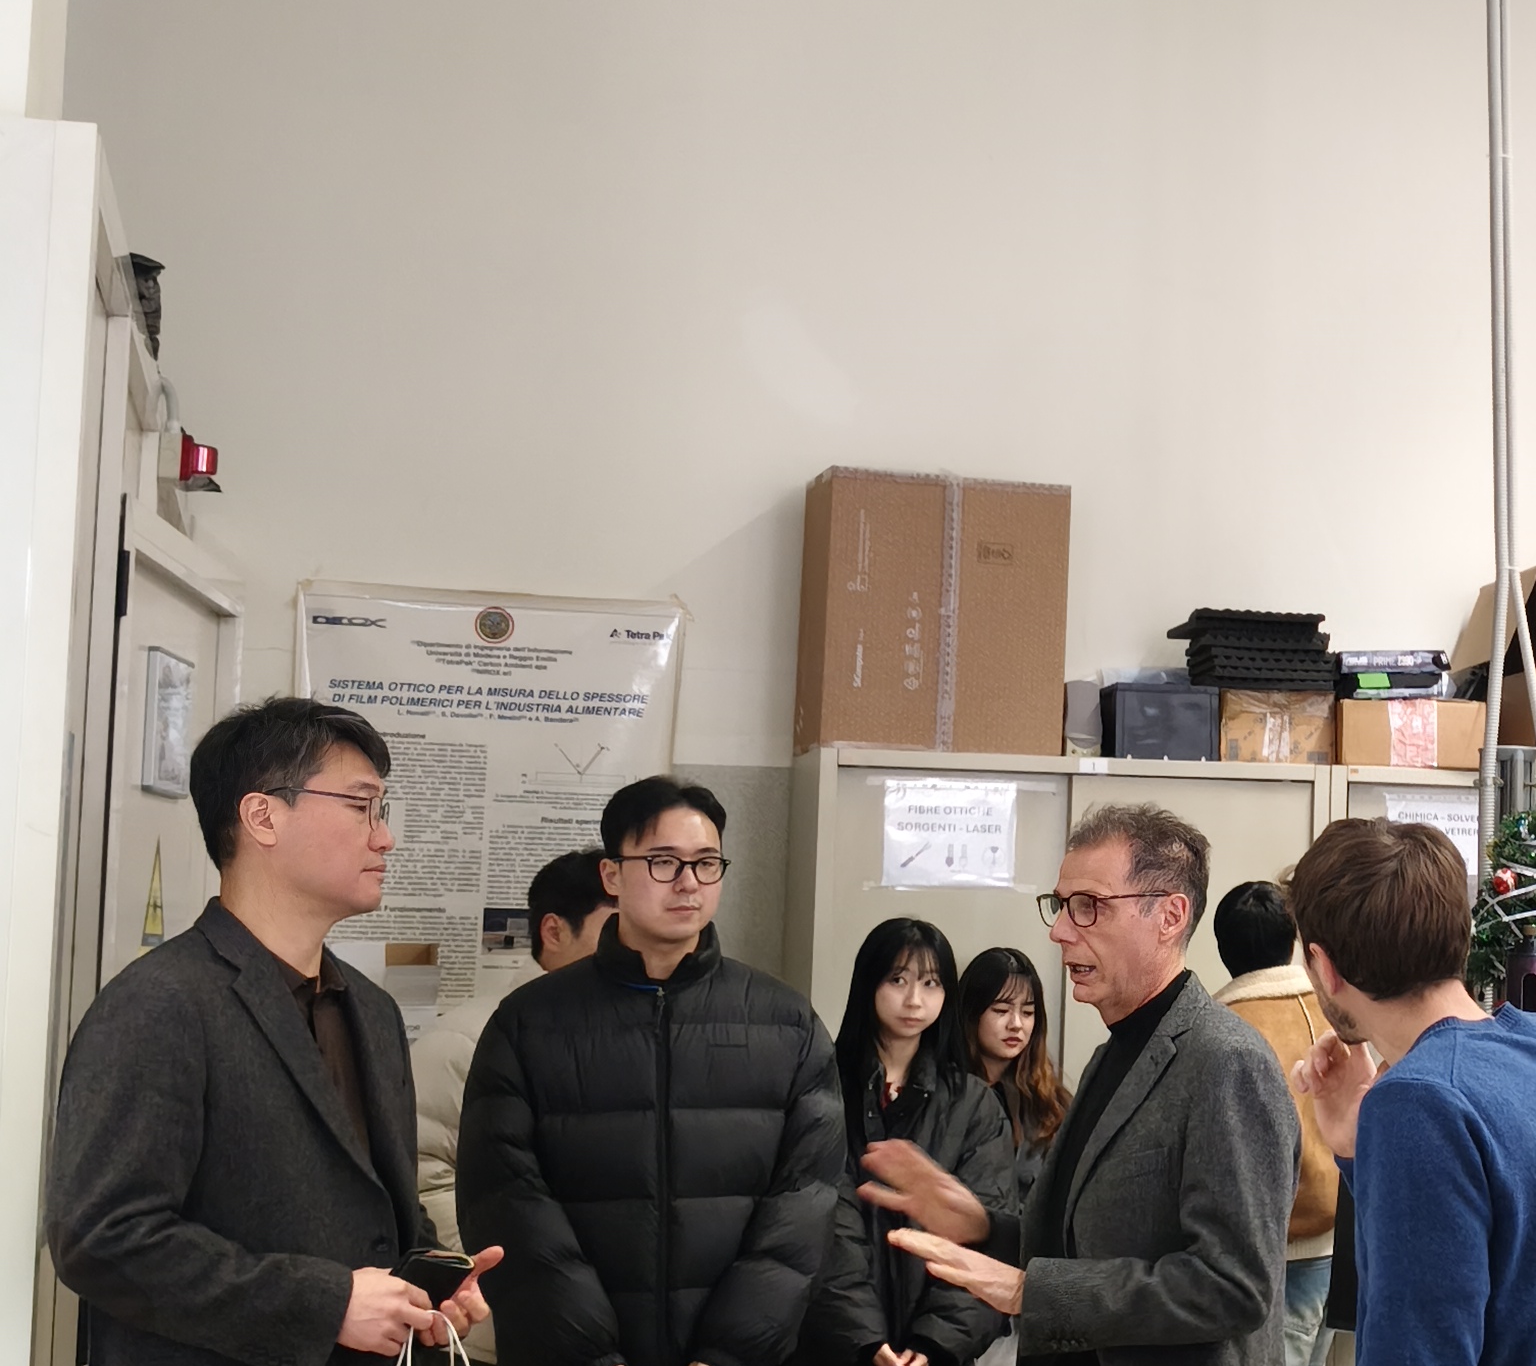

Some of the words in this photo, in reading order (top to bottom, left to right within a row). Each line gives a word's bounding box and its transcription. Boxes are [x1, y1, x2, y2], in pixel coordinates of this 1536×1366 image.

[624, 629, 651, 640] Tetra
[328, 678, 385, 691] SISTEMA
[388, 681, 436, 694] OTTICO
[438, 684, 465, 695] PER
[466, 686, 483, 696] LA
[486, 687, 535, 698] MISURA
[537, 690, 580, 701] DELLO
[582, 692, 650, 704] SPESSORE
[332, 693, 346, 703] DI
[348, 694, 378, 704] FILM
[380, 695, 454, 709] POLIMERICI
[456, 699, 482, 710] PER
[485, 700, 562, 713] L'INDUSTRIA
[565, 705, 645, 718] ALIMENTARE
[908, 804, 941, 815] FIBRE
[1397, 811, 1439, 821] CHIMICA
[1446, 813, 1478, 823] SOLVE
[897, 821, 957, 833] SORGENTI
[966, 824, 1002, 834] LASER
